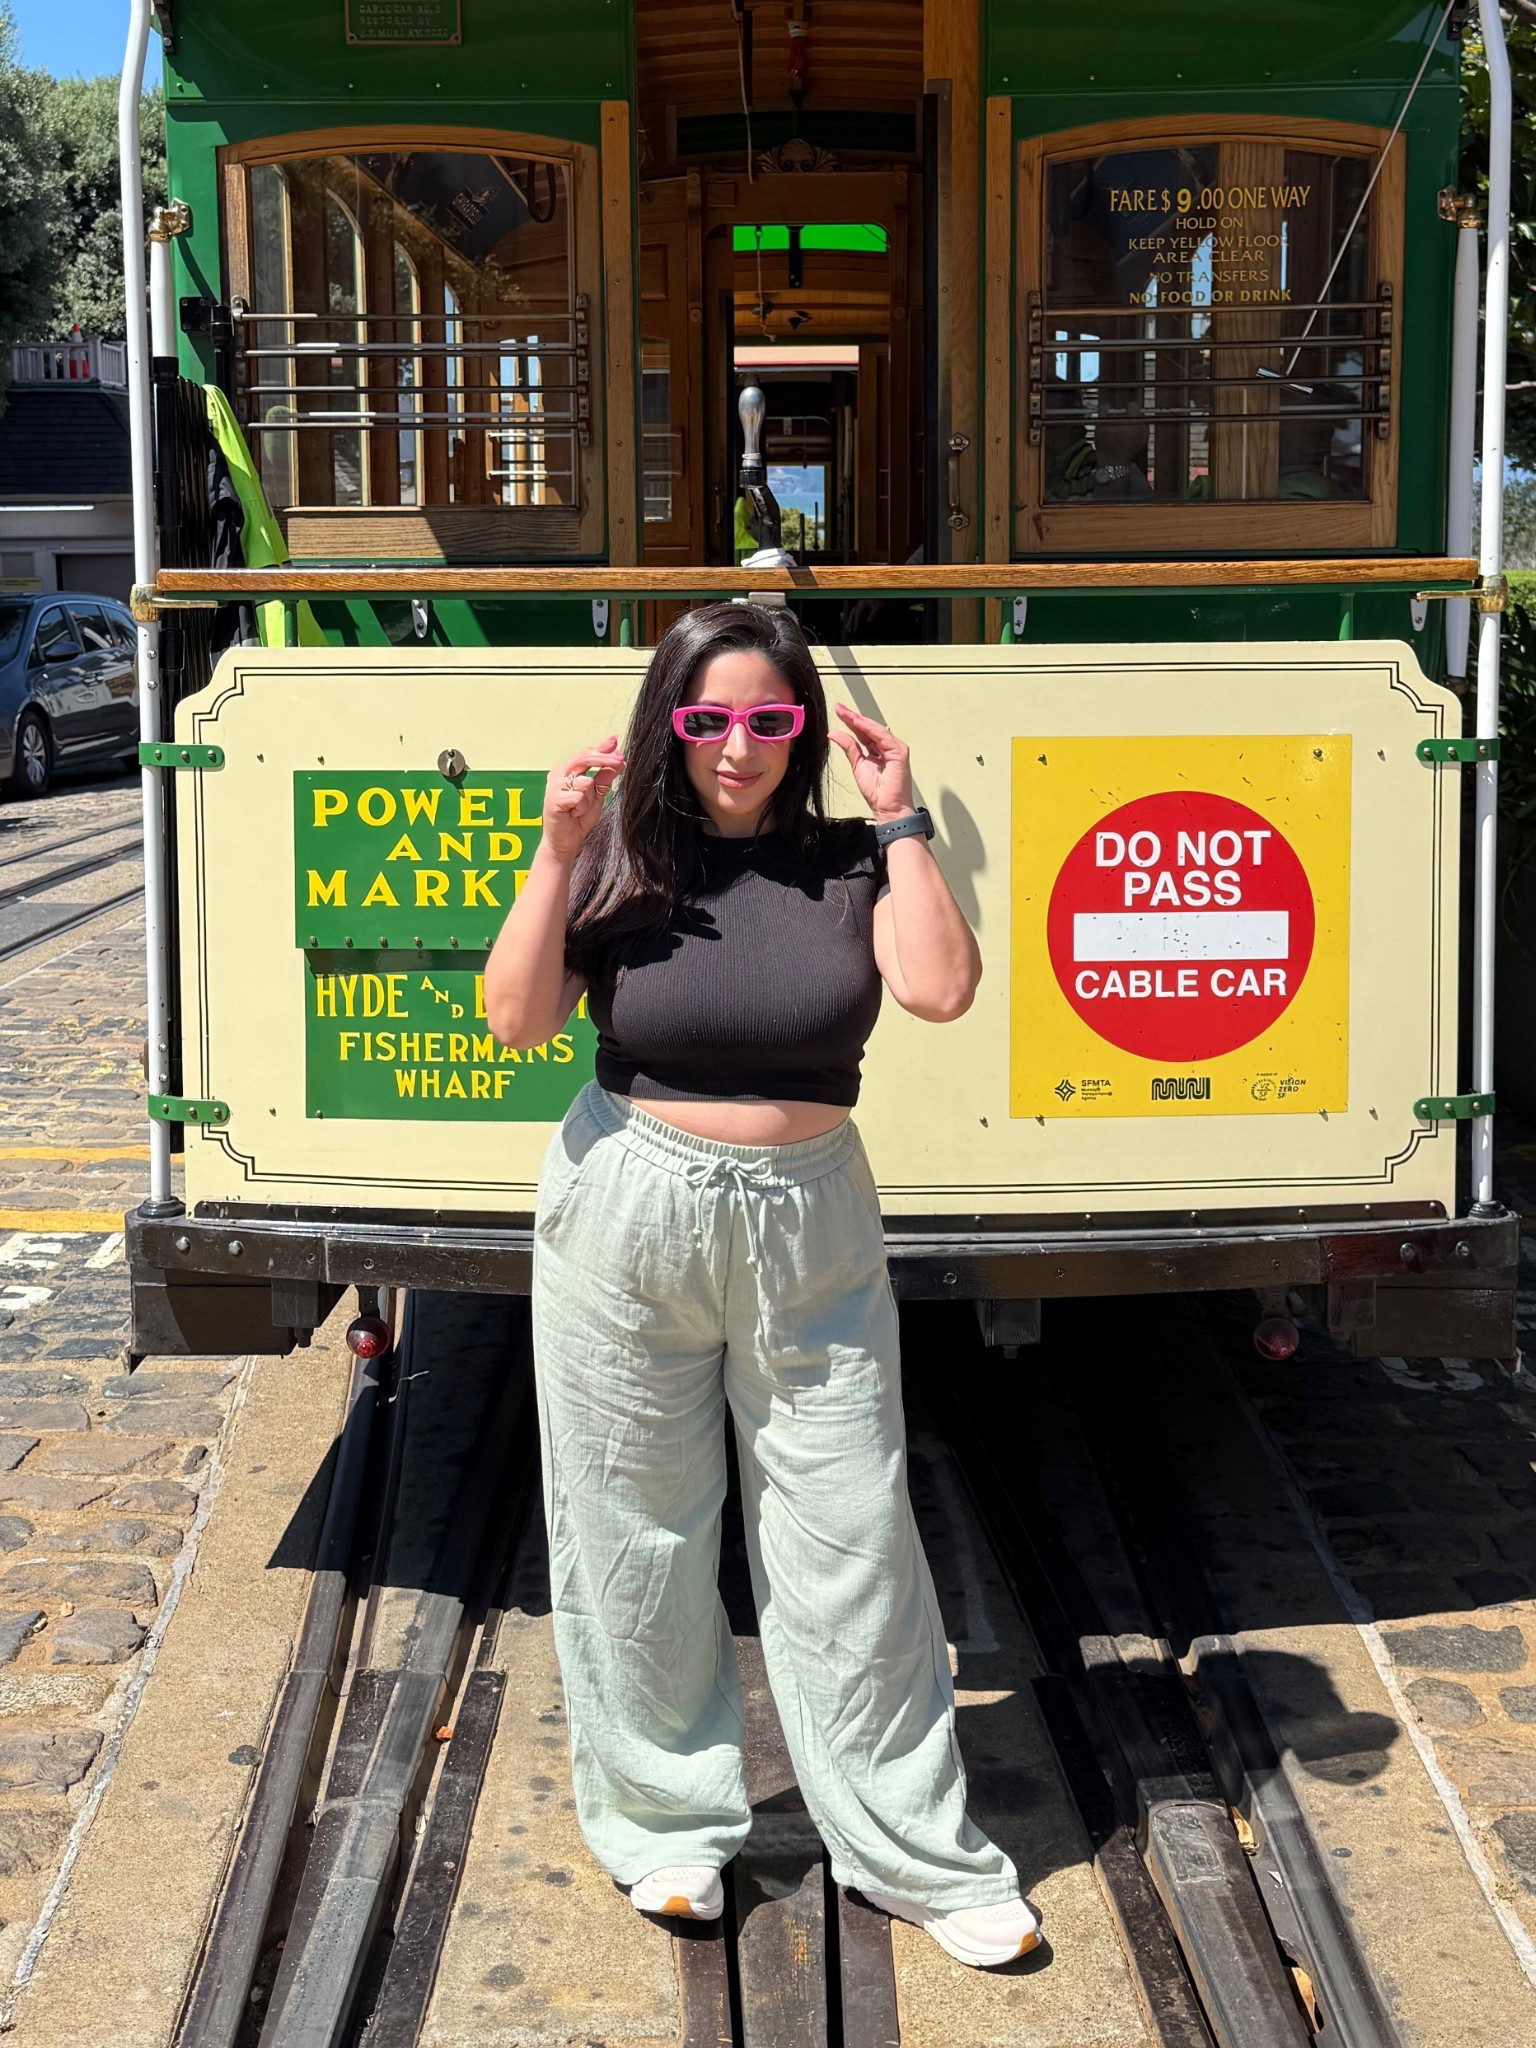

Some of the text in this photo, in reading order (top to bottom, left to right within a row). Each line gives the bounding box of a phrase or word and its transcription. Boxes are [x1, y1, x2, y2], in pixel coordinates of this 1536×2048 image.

[394, 4, 413, 14] CAR
[1110, 189, 1157, 212] FARE
[1228, 187, 1266, 209] ONE
[1270, 186, 1311, 208] WAY
[1176, 216, 1243, 230] HOLD ON
[1129, 238, 1165, 250] KEEP
[1169, 236, 1233, 249] YELLOW
[1153, 250, 1265, 263] AREA CLEAR
[1150, 270, 1269, 284] NO TRANSFERS
[1129, 289, 1291, 304] NO FOOD OR DRINK
[312, 787, 543, 827] POWEL
[385, 832, 523, 862] AND
[1096, 830, 1272, 867] DO NOT
[306, 869, 529, 907] MARK
[1124, 870, 1242, 907] PASS
[316, 974, 409, 1018] HYDE
[1075, 968, 1287, 999] CABLE CAR
[339, 1031, 575, 1064] FISHERMANS
[394, 1069, 515, 1099] WHARF
[1081, 1079, 1112, 1087] SFMTA
